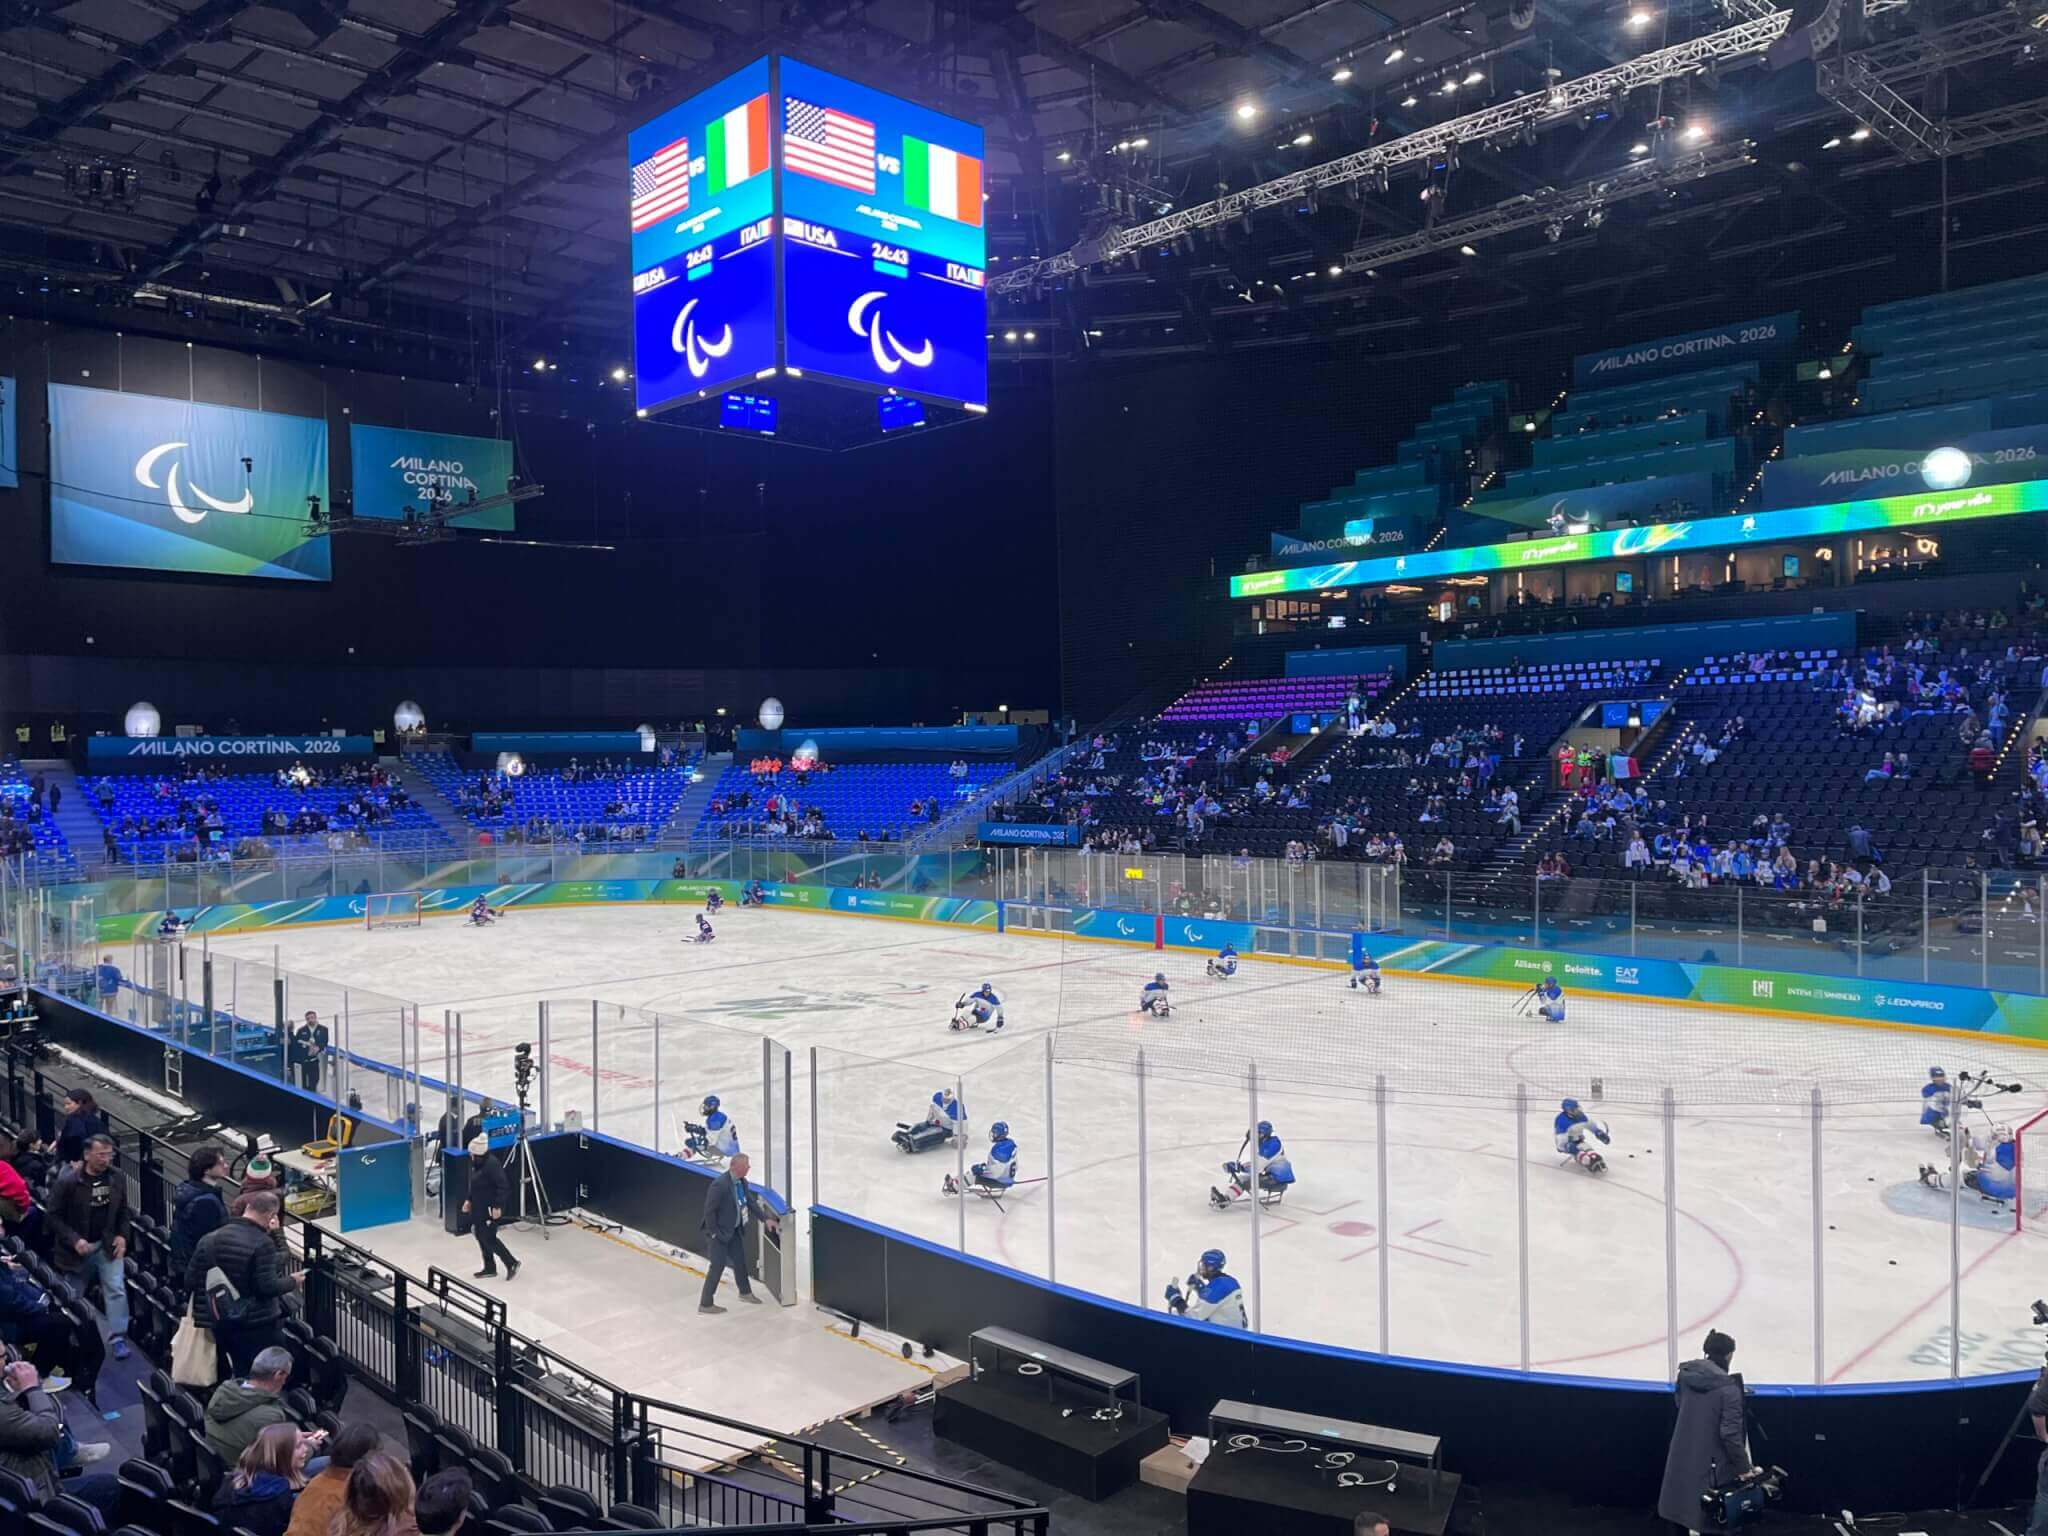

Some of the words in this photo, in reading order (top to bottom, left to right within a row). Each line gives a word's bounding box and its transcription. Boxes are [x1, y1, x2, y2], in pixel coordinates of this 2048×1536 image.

[804, 223, 838, 249] USA
[872, 243, 909, 265] 24:43
[947, 263, 970, 282] ITA
[1591, 348, 1657, 373] MILANO
[1661, 334, 1736, 359] CORTINA
[1739, 324, 1776, 343] 2026
[390, 456, 463, 474] MILANO
[1819, 464, 1899, 486] MILANO
[1994, 446, 2036, 464] 2026
[403, 472, 479, 493] CORTINA
[1278, 541, 1325, 556] MILANO
[1327, 535, 1377, 549] CORTINA
[1379, 530, 1404, 544] 2026
[128, 741, 215, 755] MILANO
[218, 740, 301, 754] CORTINA
[304, 740, 341, 754] 2026
[990, 829, 1019, 838] MILANO
[1020, 830, 1052, 839] CORTINA
[1514, 959, 1541, 970] Allianz
[1615, 966, 1639, 979] EA7
[1887, 997, 1945, 1010] LEONARDO
